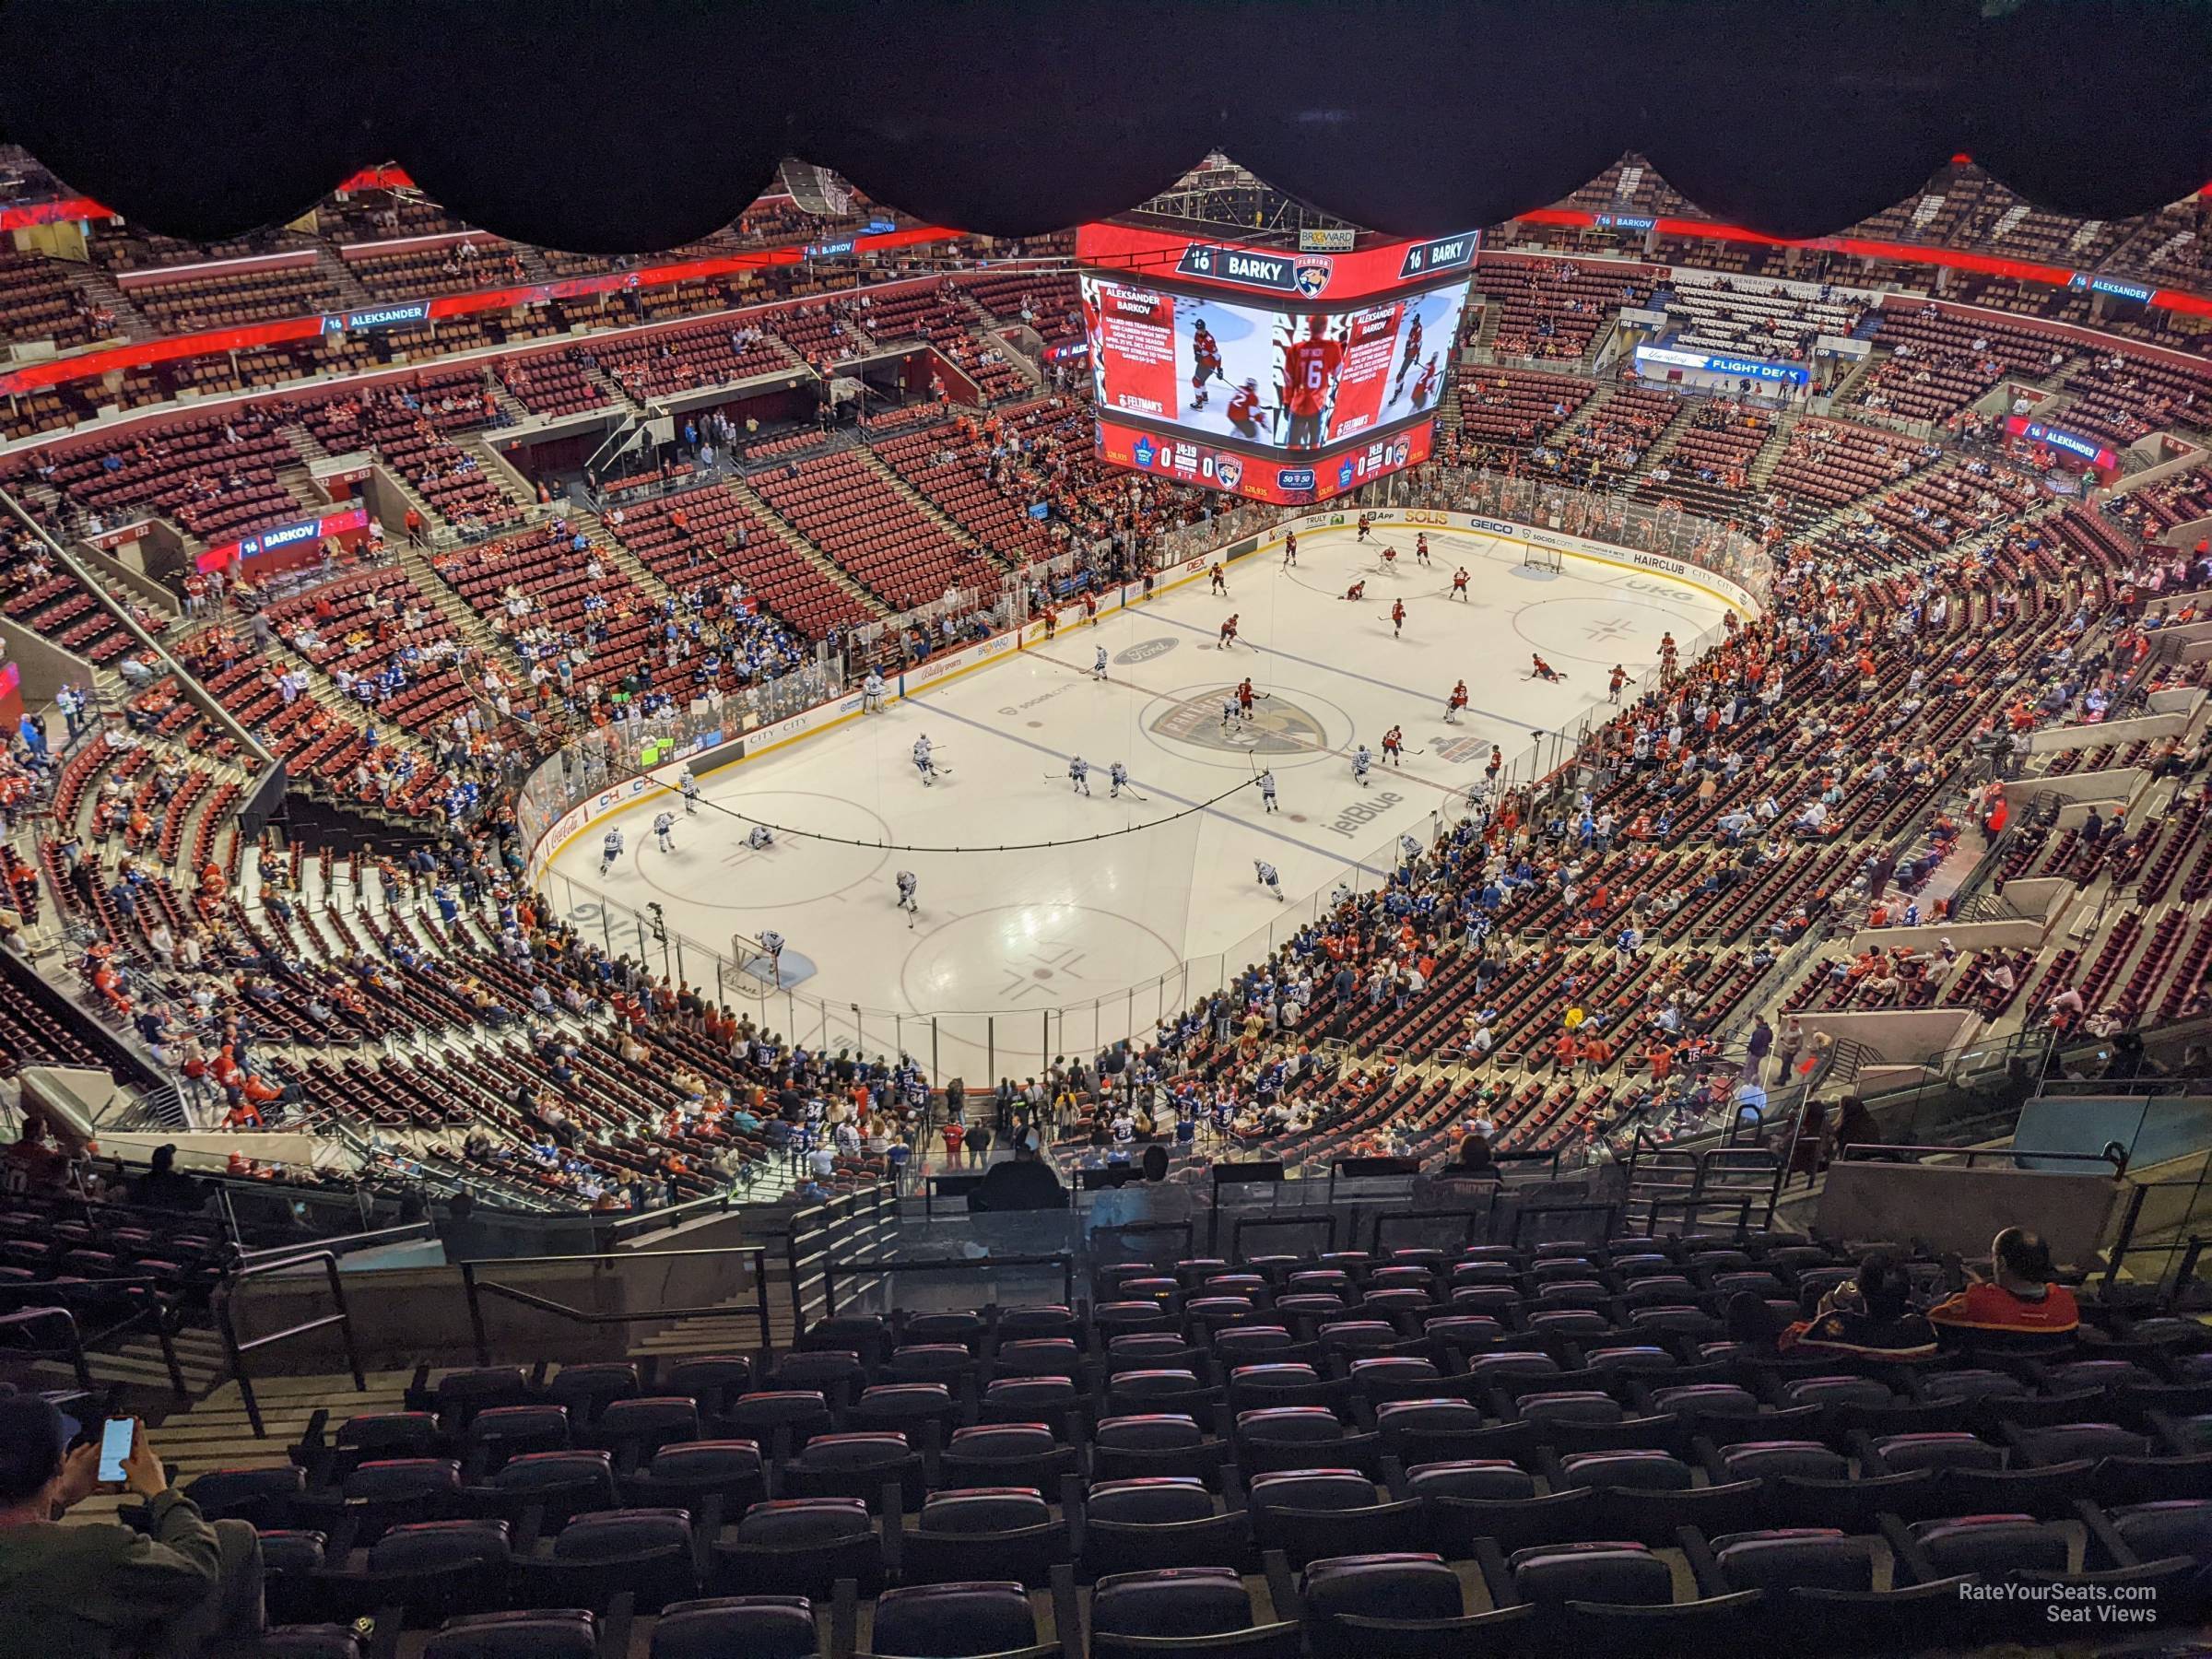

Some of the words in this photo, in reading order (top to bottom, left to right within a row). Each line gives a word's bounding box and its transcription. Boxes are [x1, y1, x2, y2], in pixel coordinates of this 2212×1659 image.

[1617, 218, 1652, 228] BARKOV
[1409, 251, 1421, 269] 16
[1431, 241, 1464, 264] BARKY
[1192, 251, 1210, 270] 16
[1229, 257, 1283, 281] BARKY
[1734, 277, 1779, 288] GENERATION
[2077, 277, 2087, 286] 16
[2092, 280, 2147, 300] ALEKSANDER
[1106, 288, 1160, 305] ALEKSANDER
[1117, 300, 1150, 315] BARKOV
[1358, 307, 1395, 324] ALEKSANDER
[329, 319, 342, 329] 16
[351, 307, 422, 326] ALEKSANDER
[1620, 320, 1632, 328] 108
[1816, 348, 1830, 357] 109
[1712, 359, 1759, 374] FLIGHT
[1127, 395, 1163, 413] FELTMAN'S
[1175, 442, 1197, 458] 14:19
[2030, 427, 2041, 437] 16
[2046, 432, 2094, 458] ALEKSANDER
[1160, 447, 1171, 467] 0
[1385, 446, 1393, 466] 0
[1202, 457, 1213, 477] 0
[1358, 457, 1365, 477] 0
[1282, 475, 1293, 483] 50
[1300, 475, 1311, 483] 50
[1306, 515, 1327, 524] TRULY
[1405, 511, 1448, 525] SOLIS
[1470, 518, 1513, 535] GEICO
[244, 542, 257, 553] 16
[265, 524, 314, 547] BARKOV
[1186, 556, 1206, 571] DEX
[1634, 553, 1685, 575] HAIRCLUB
[1692, 569, 1712, 582] CITY
[1626, 580, 1694, 601] UKG
[1717, 579, 1735, 593] CITY
[1127, 643, 1168, 662] Ford
[922, 662, 946, 680] Bally
[783, 716, 807, 732] CITY
[750, 729, 775, 745] CITY
[1322, 790, 1406, 840] jetBlue
[1688, 1052, 1700, 1063] 16
[806, 1104, 823, 1117] 34
